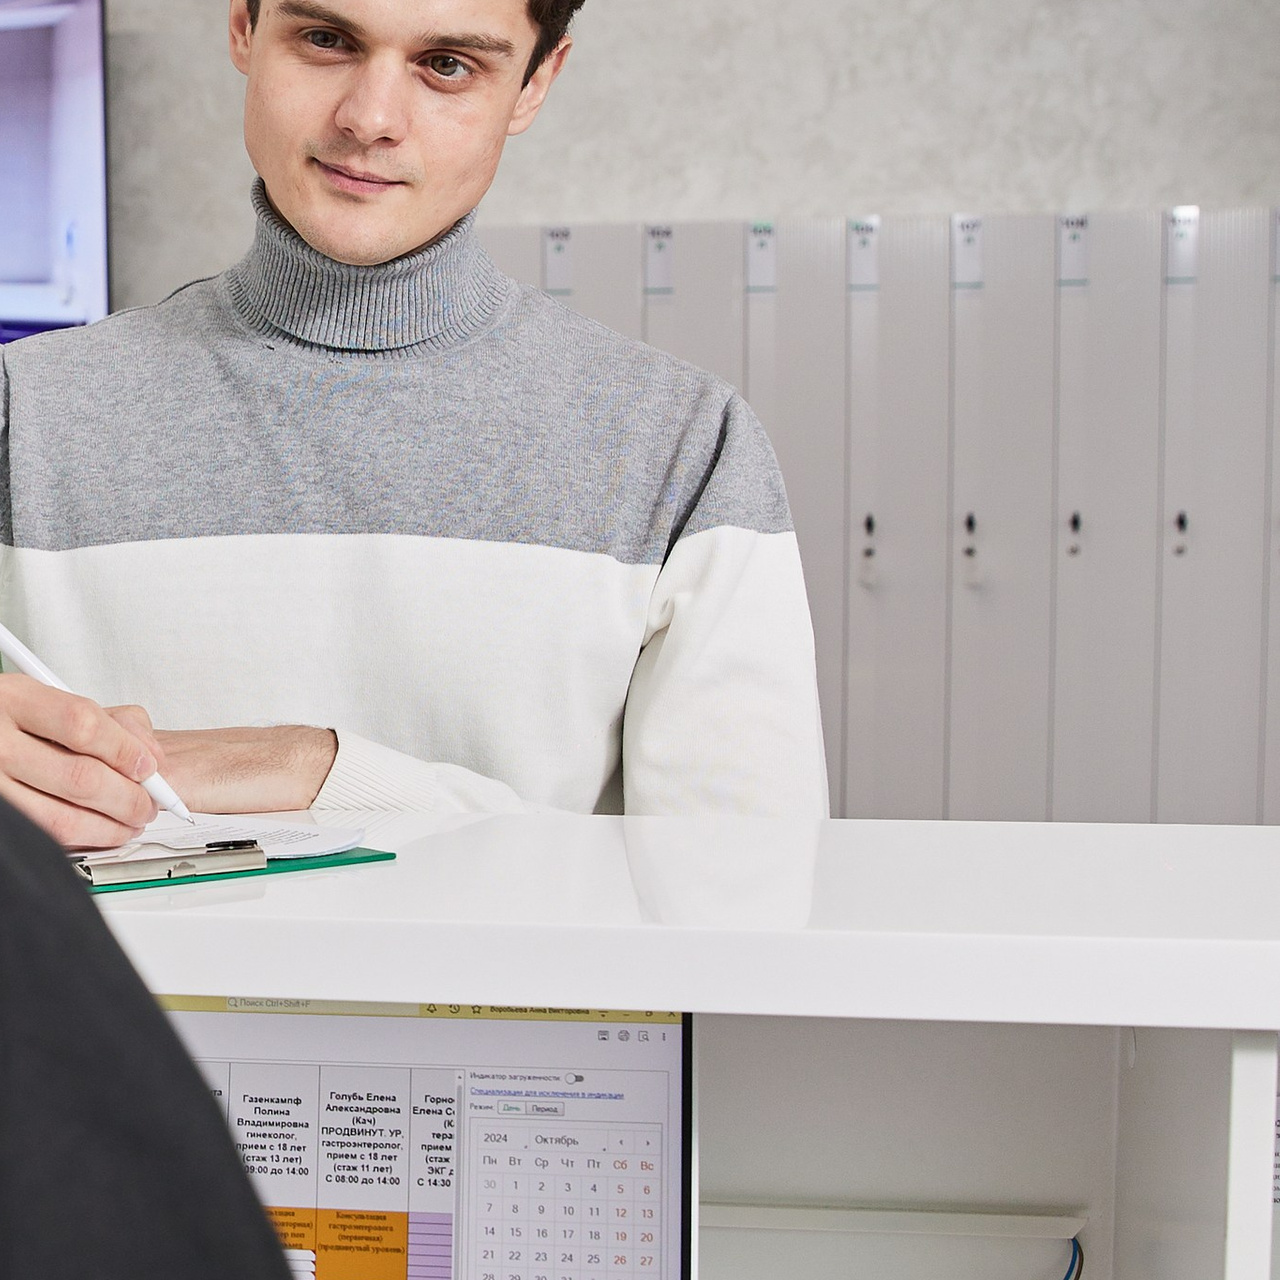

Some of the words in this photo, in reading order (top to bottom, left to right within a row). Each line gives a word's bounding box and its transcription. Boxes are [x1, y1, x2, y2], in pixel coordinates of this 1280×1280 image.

[240, 998, 264, 1007] Поиск
[265, 999, 311, 1008] Ctrl+Shift+F
[470, 1072, 506, 1081] Индикатор
[243, 1094, 302, 1106] Газенкампф
[330, 1091, 364, 1102] Голубь
[366, 1093, 396, 1102] Елена
[254, 1106, 290, 1116] Полина
[325, 1103, 401, 1114] Александровна
[412, 1106, 443, 1115] Елена
[503, 1103, 521, 1112] День
[532, 1105, 558, 1114] Период
[237, 1117, 309, 1129] Владимировна
[352, 1116, 376, 1126] (Кач)
[246, 1131, 297, 1140] гинеколог,
[483, 1134, 508, 1143] 2024
[535, 1135, 579, 1147] Октябрь
[236, 1143, 267, 1151] прием
[277, 1143, 287, 1151] 18
[290, 1144, 307, 1152] лет
[421, 1143, 452, 1152] прием
[242, 1153, 267, 1163] (стаж
[270, 1154, 280, 1162] 13
[282, 1155, 302, 1165] лет)
[326, 1152, 357, 1160] прием
[368, 1152, 378, 1160] 18
[425, 1155, 450, 1164] (стаж
[483, 1155, 497, 1165] Пн
[509, 1156, 522, 1166] Вт
[534, 1158, 549, 1169] Ср
[561, 1159, 575, 1168] Чт
[587, 1159, 601, 1169] Пт
[613, 1159, 628, 1170] Сб
[640, 1161, 654, 1171] Вс
[270, 1167, 283, 1175] до
[286, 1167, 309, 1175] 14:00
[333, 1163, 358, 1172] (стаж
[361, 1164, 370, 1172] 11
[372, 1165, 392, 1174] лет)
[427, 1166, 446, 1175] ЭКГ
[325, 1174, 332, 1183] С
[335, 1175, 359, 1184] 08:00
[377, 1176, 401, 1185] 14:00
[417, 1177, 424, 1186] С
[427, 1179, 451, 1187] 14:30
[484, 1180, 496, 1189] 30
[538, 1182, 545, 1191] 2
[564, 1183, 571, 1192] 3
[590, 1183, 597, 1193] 4
[617, 1184, 624, 1193] 5
[643, 1185, 650, 1195] 6
[486, 1203, 493, 1212] 7
[512, 1204, 519, 1214] 8
[538, 1205, 545, 1215] 9
[563, 1206, 574, 1215] 10
[589, 1207, 600, 1216] 11
[615, 1208, 627, 1218] 12
[642, 1209, 653, 1218] 13
[338, 1234, 383, 1243] (первичная)
[484, 1226, 495, 1236] 14
[510, 1227, 522, 1237] 15
[536, 1228, 548, 1238] 16
[562, 1229, 574, 1239] 17
[589, 1231, 600, 1240] 18
[615, 1232, 627, 1241] 19
[640, 1233, 653, 1242] 20
[483, 1250, 495, 1259] 21
[508, 1251, 521, 1261] 22
[534, 1252, 548, 1262] 23
[561, 1253, 573, 1262] 24
[587, 1254, 600, 1264] 25
[613, 1255, 627, 1265] 26
[640, 1256, 653, 1266] 27
